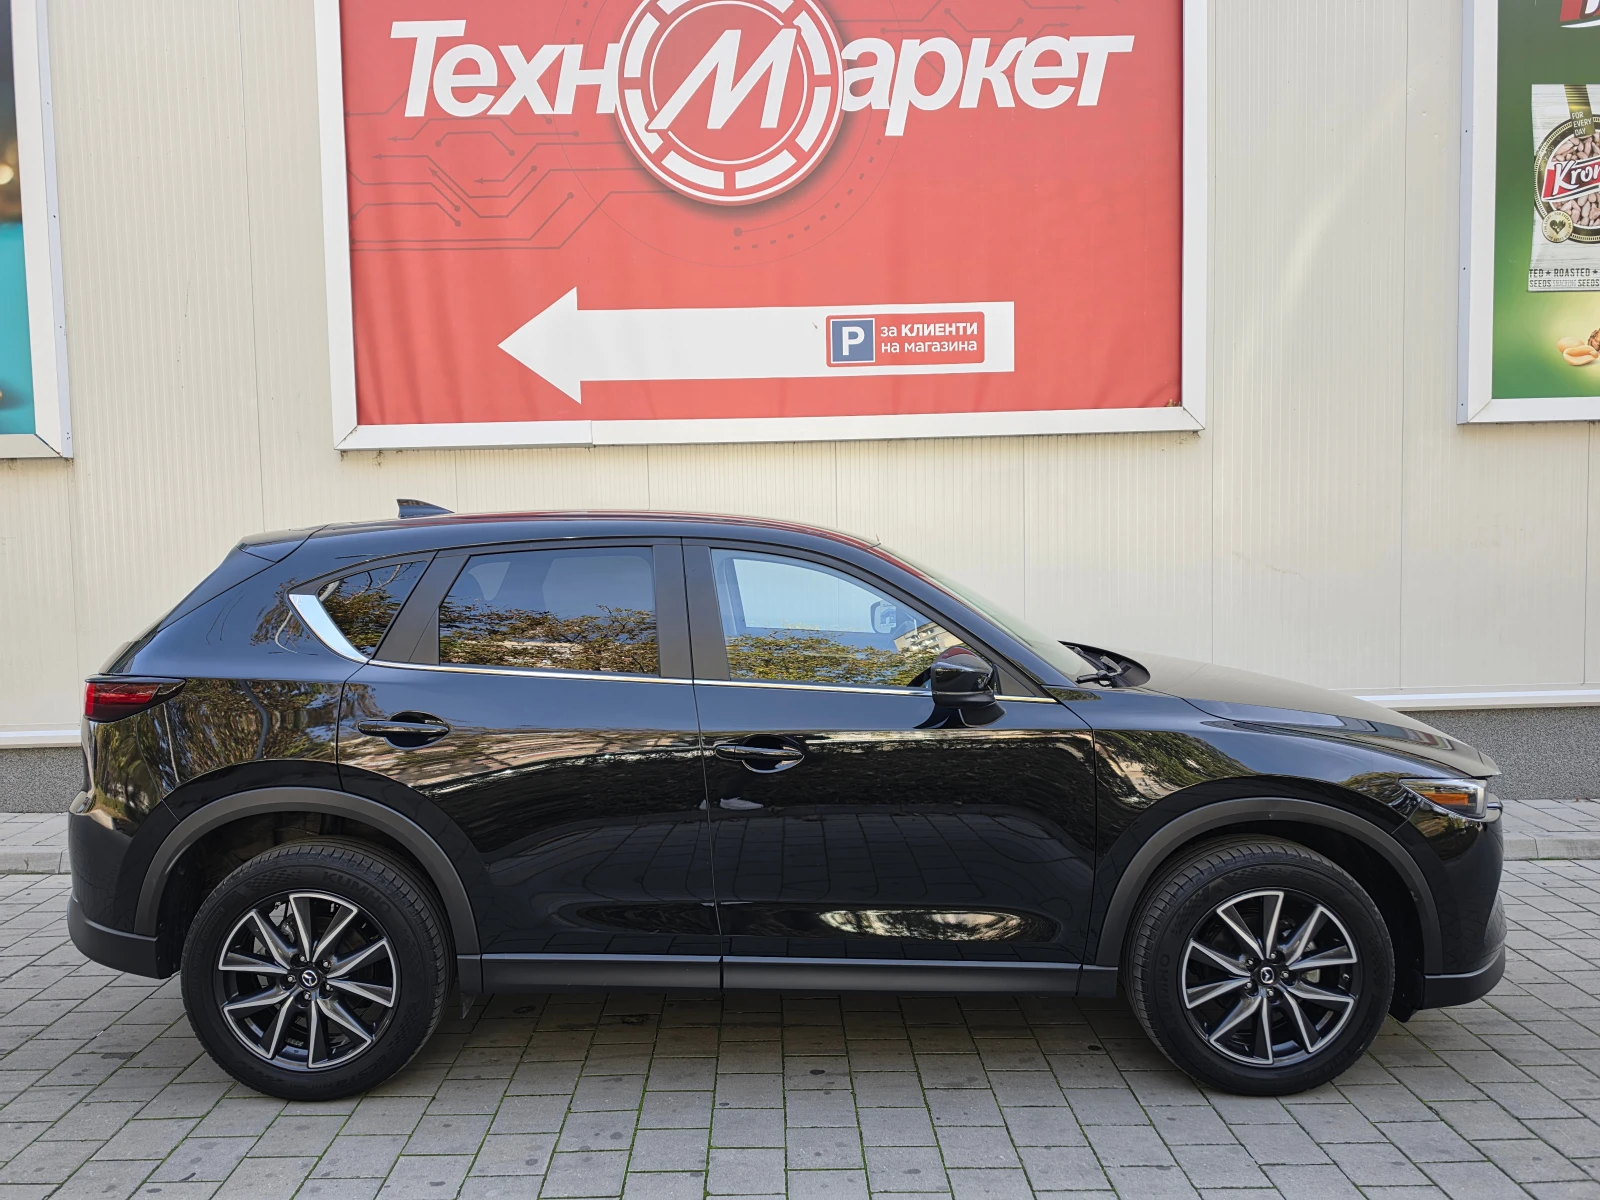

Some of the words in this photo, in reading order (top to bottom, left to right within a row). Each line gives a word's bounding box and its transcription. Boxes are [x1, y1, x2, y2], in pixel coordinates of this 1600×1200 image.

[1571, 111, 1584, 119] FOR
[1573, 118, 1592, 128] EVERY
[1574, 127, 1586, 136] DAY
[1553, 267, 1590, 277] ROASTED
[1529, 279, 1552, 288] SEEDS
[1577, 278, 1600, 287] SEEDS
[880, 326, 898, 337] за
[901, 322, 978, 337] КЛИЕНТИ
[881, 342, 900, 353] на
[904, 340, 978, 353] магазина
[320, 871, 392, 914] KUMHO
